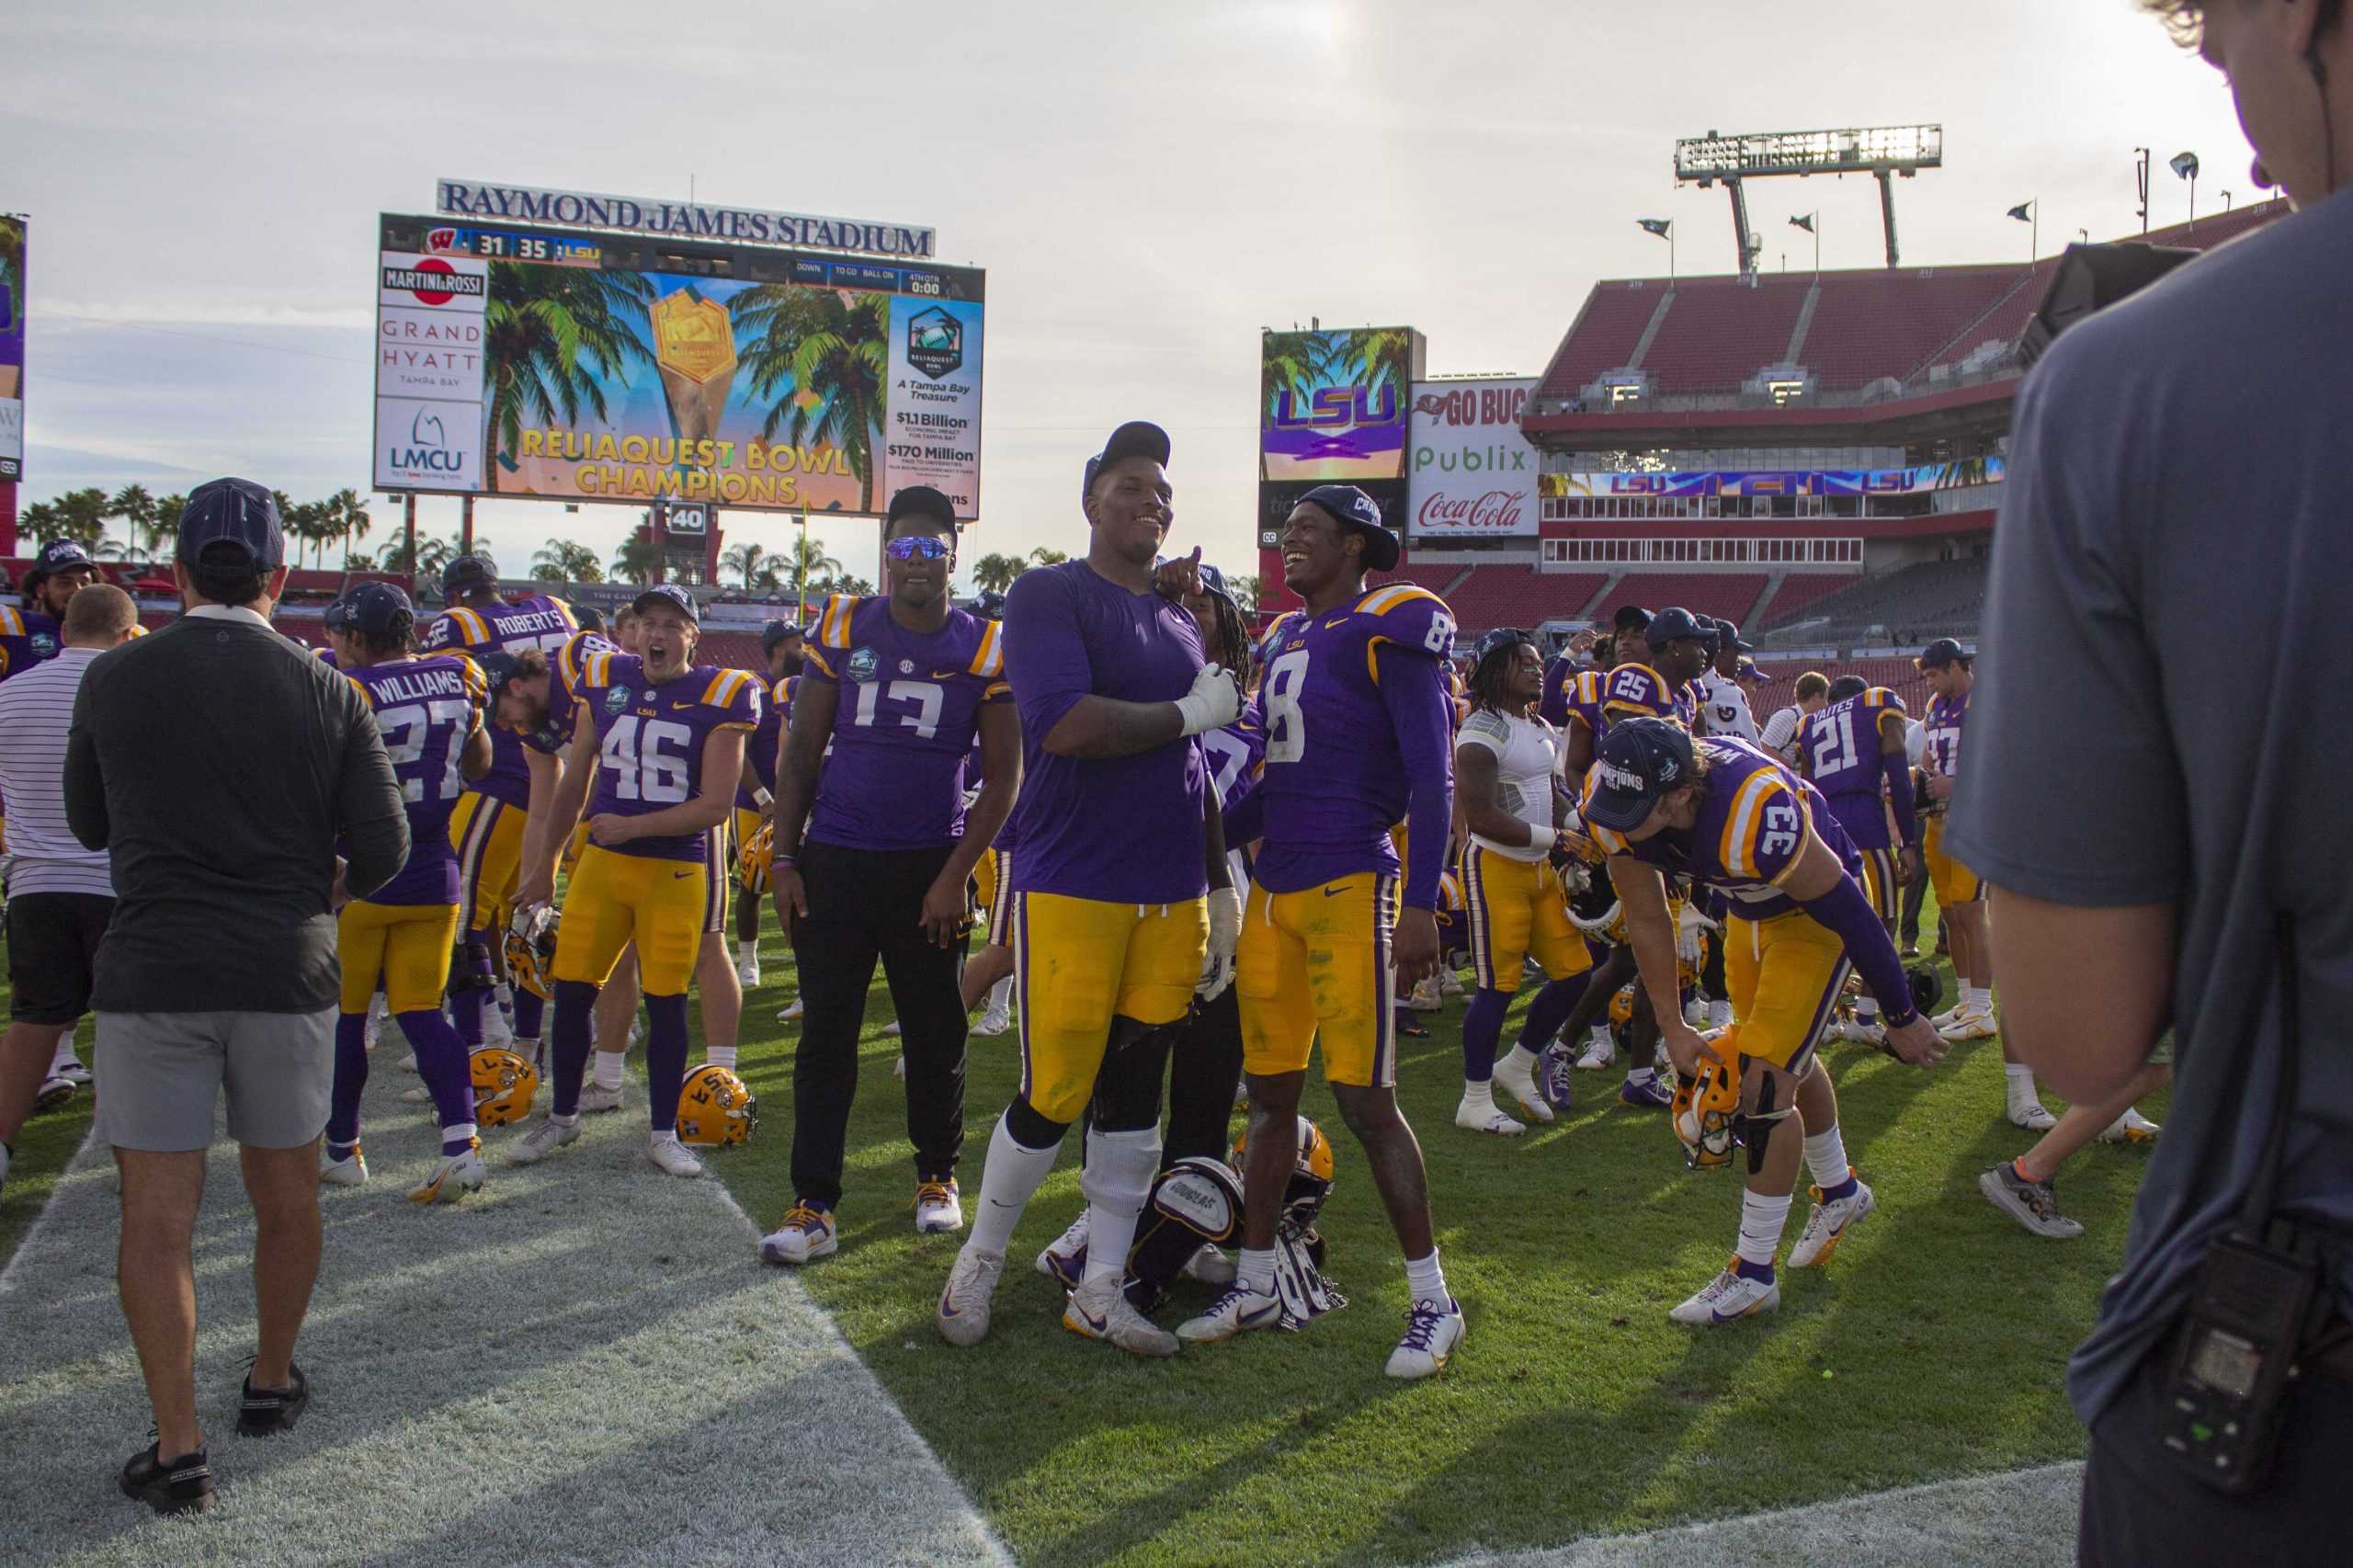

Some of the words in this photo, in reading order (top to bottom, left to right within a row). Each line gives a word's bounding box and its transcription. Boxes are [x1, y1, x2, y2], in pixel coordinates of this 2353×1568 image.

[442, 183, 642, 228] RAYMOND
[646, 204, 769, 240] JAMES
[778, 215, 933, 256] STADIUM
[480, 235, 503, 256] 31
[519, 238, 547, 258] 35
[565, 244, 599, 259] LSU
[796, 263, 821, 273] DOWN
[862, 269, 881, 278] BALL
[882, 270, 894, 279] ON
[912, 281, 939, 294] 0:00
[382, 320, 480, 342] GRAND
[383, 349, 476, 369] HYATT
[912, 354, 954, 364] RELIAQUEST
[400, 375, 436, 385] TAMPA
[439, 377, 460, 387] BAY
[897, 380, 906, 389] A
[910, 381, 948, 392] Tampa
[949, 383, 971, 395] Bay
[911, 391, 958, 403] Treasure
[1276, 382, 1398, 429] LSU
[1446, 389, 1477, 426] GO
[1481, 387, 1532, 426] BUC
[897, 412, 919, 426] $1.1
[922, 413, 968, 428] Billion
[391, 448, 462, 472] LMCU
[521, 429, 735, 468] RELIAQUEST
[747, 441, 851, 476] BOWL
[888, 444, 922, 458] $170
[925, 447, 974, 462] Million
[1415, 445, 1526, 472] Publix
[574, 465, 798, 505] CHAMPIONS
[1610, 474, 1667, 494] LSU
[1861, 469, 1915, 494] LSU
[672, 509, 704, 528] 40
[494, 609, 564, 637] ROBERTS
[1286, 639, 1305, 651] LSU
[369, 671, 463, 705] WILLIAMS
[1615, 670, 1650, 702] 25
[637, 707, 657, 717] LSU
[1265, 650, 1310, 763] 8
[1813, 698, 1855, 723] YAITES
[376, 699, 471, 803] 27
[1812, 711, 1859, 780] 21
[601, 714, 691, 802] 46
[1761, 805, 1799, 856] 33
